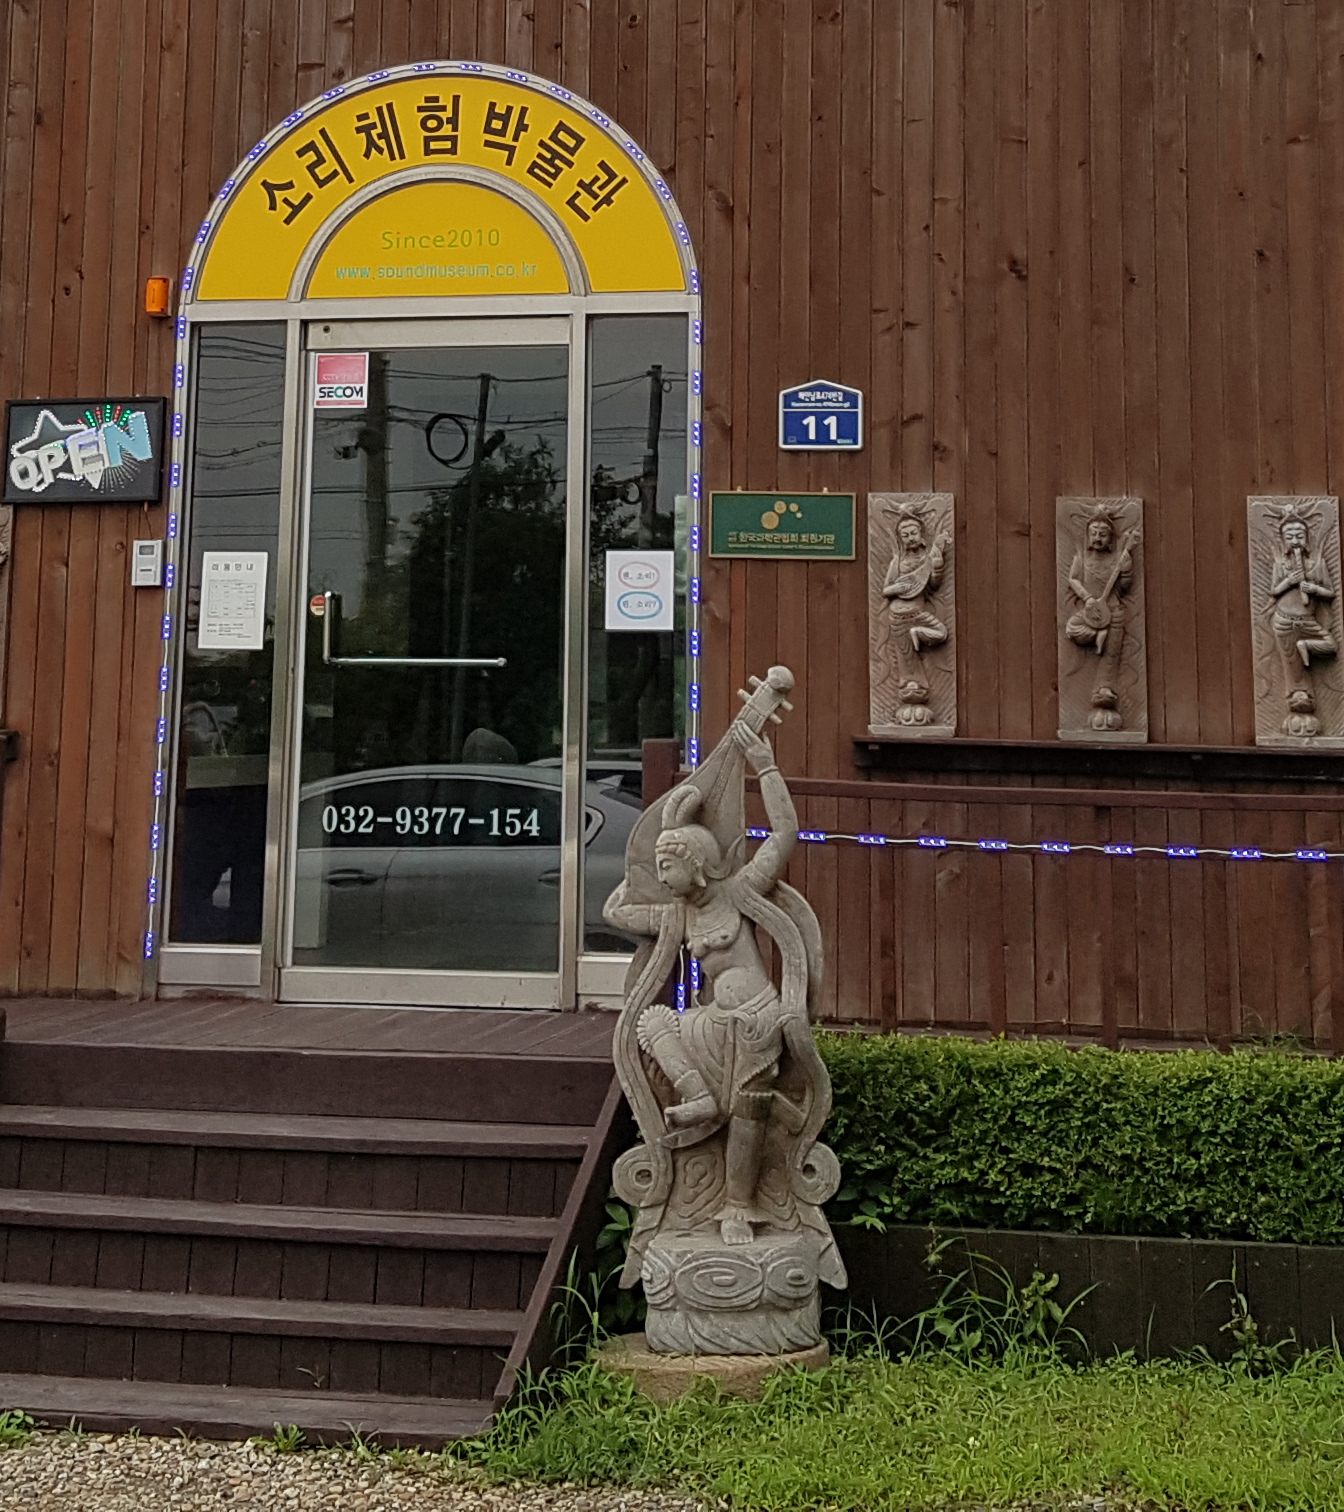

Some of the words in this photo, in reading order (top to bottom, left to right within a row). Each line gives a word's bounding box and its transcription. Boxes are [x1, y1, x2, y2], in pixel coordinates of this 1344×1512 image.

[336, 262, 537, 280] www.soundmuseum.co.kr
[319, 386, 363, 399] SECOM
[802, 415, 837, 440] 11
[10, 411, 153, 491] OPEN
[322, 805, 541, 836] 032-9377-154
